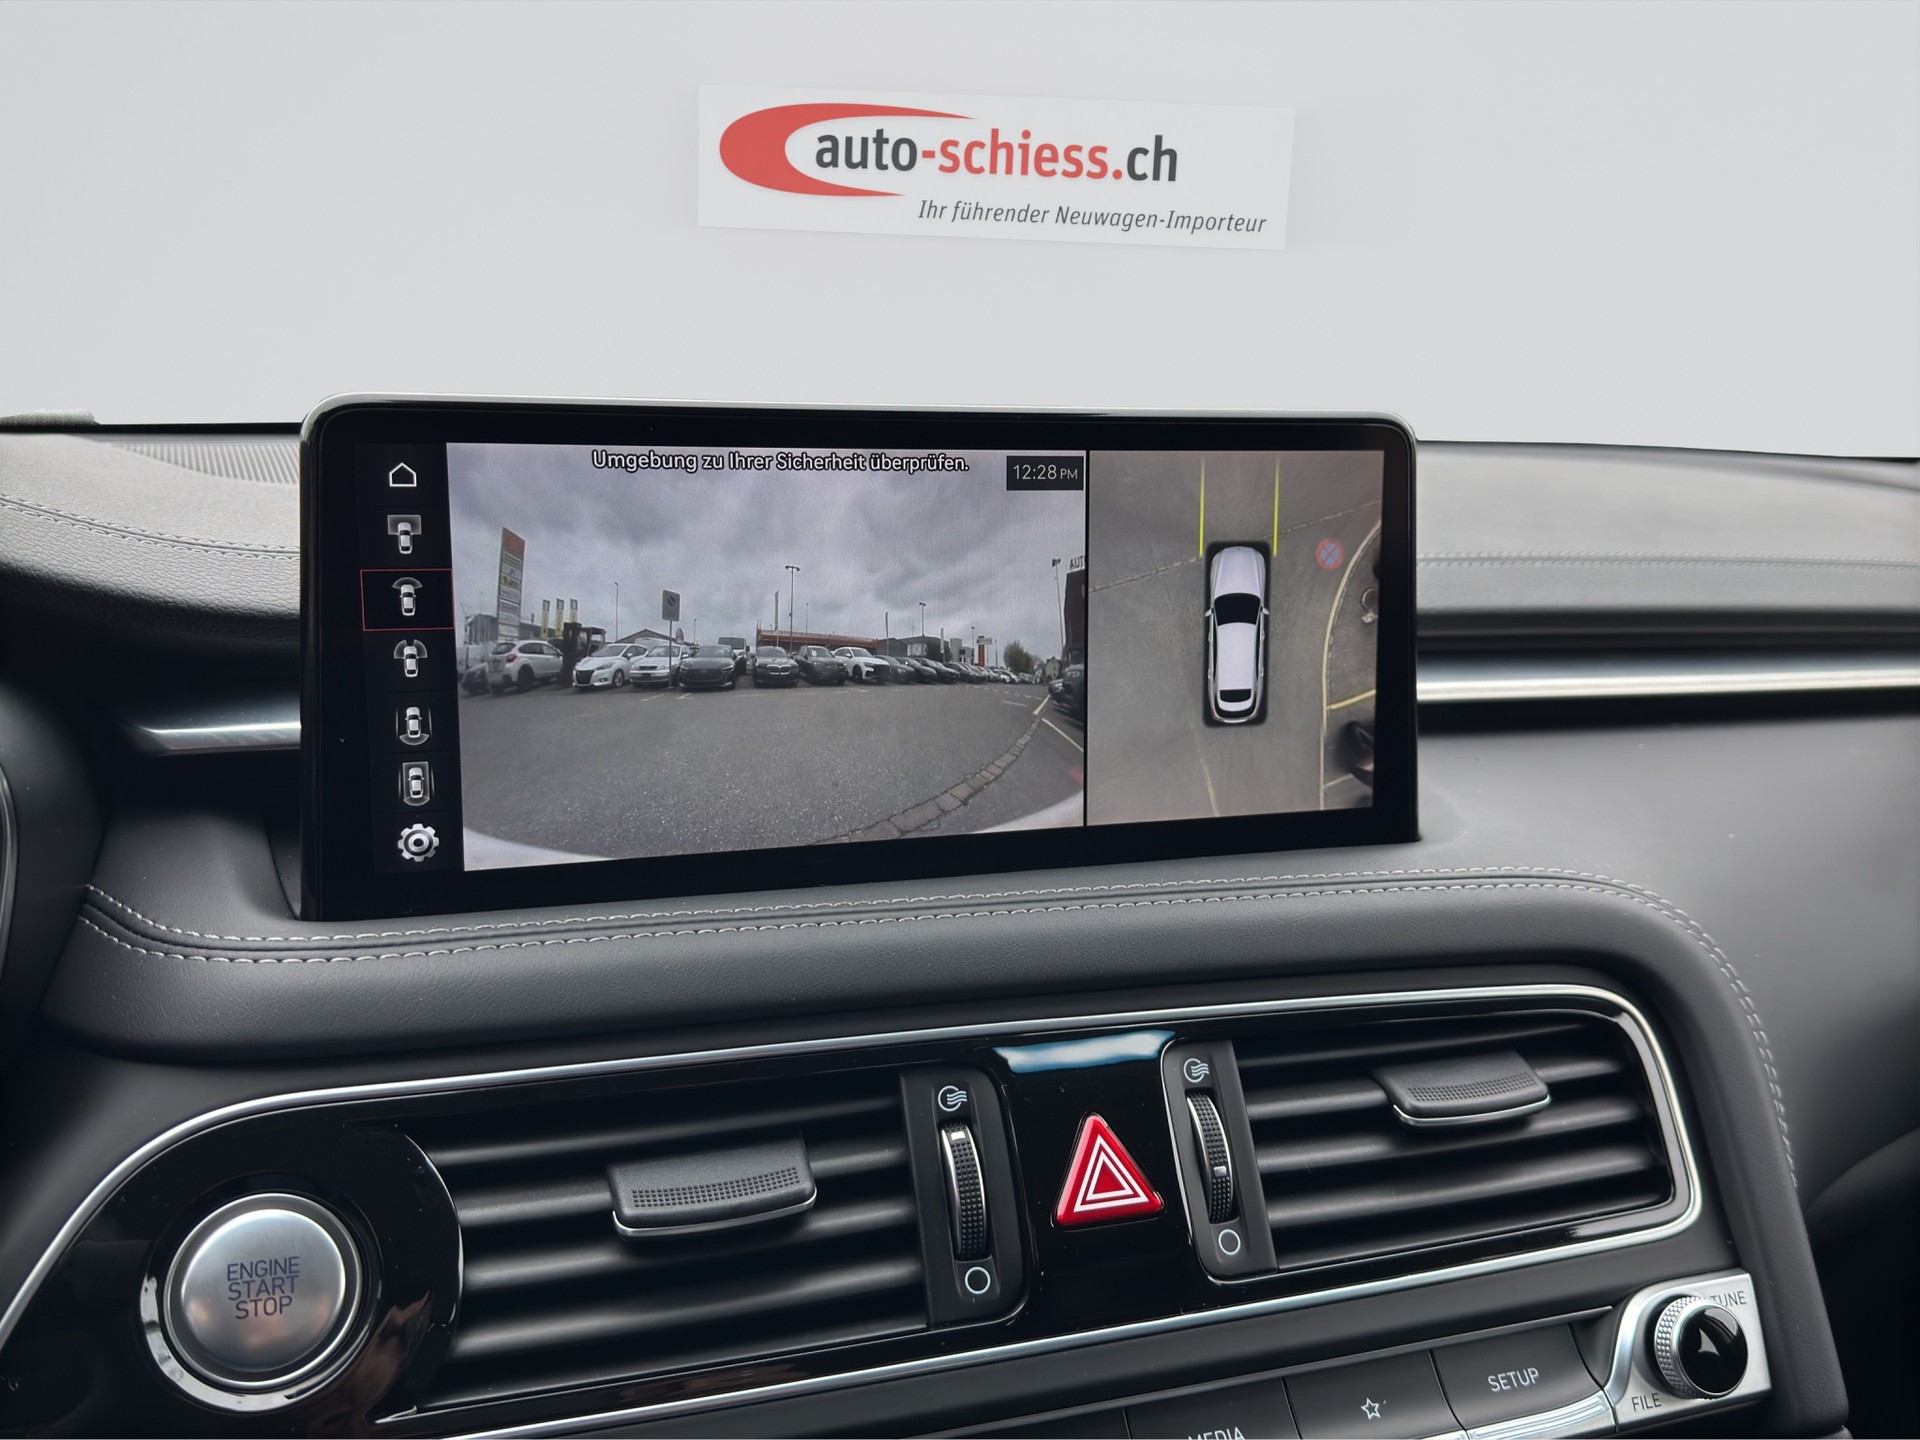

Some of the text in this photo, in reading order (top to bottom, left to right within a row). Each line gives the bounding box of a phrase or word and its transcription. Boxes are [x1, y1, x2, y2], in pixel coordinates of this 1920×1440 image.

[815, 128, 1178, 182] auto-schiess.ch
[918, 200, 1267, 234] Ihr führender Neuwagen-Importeur
[592, 450, 970, 474] Umgebung zu Ihrer Sicherheit überprüfen.
[1013, 464, 1078, 480] 12:28 PM
[227, 1256, 301, 1281] ENGINE
[228, 1275, 300, 1301] START
[235, 1295, 293, 1320] STOP
[1487, 1367, 1539, 1392] SETUP
[1631, 1392, 1662, 1411] FILE
